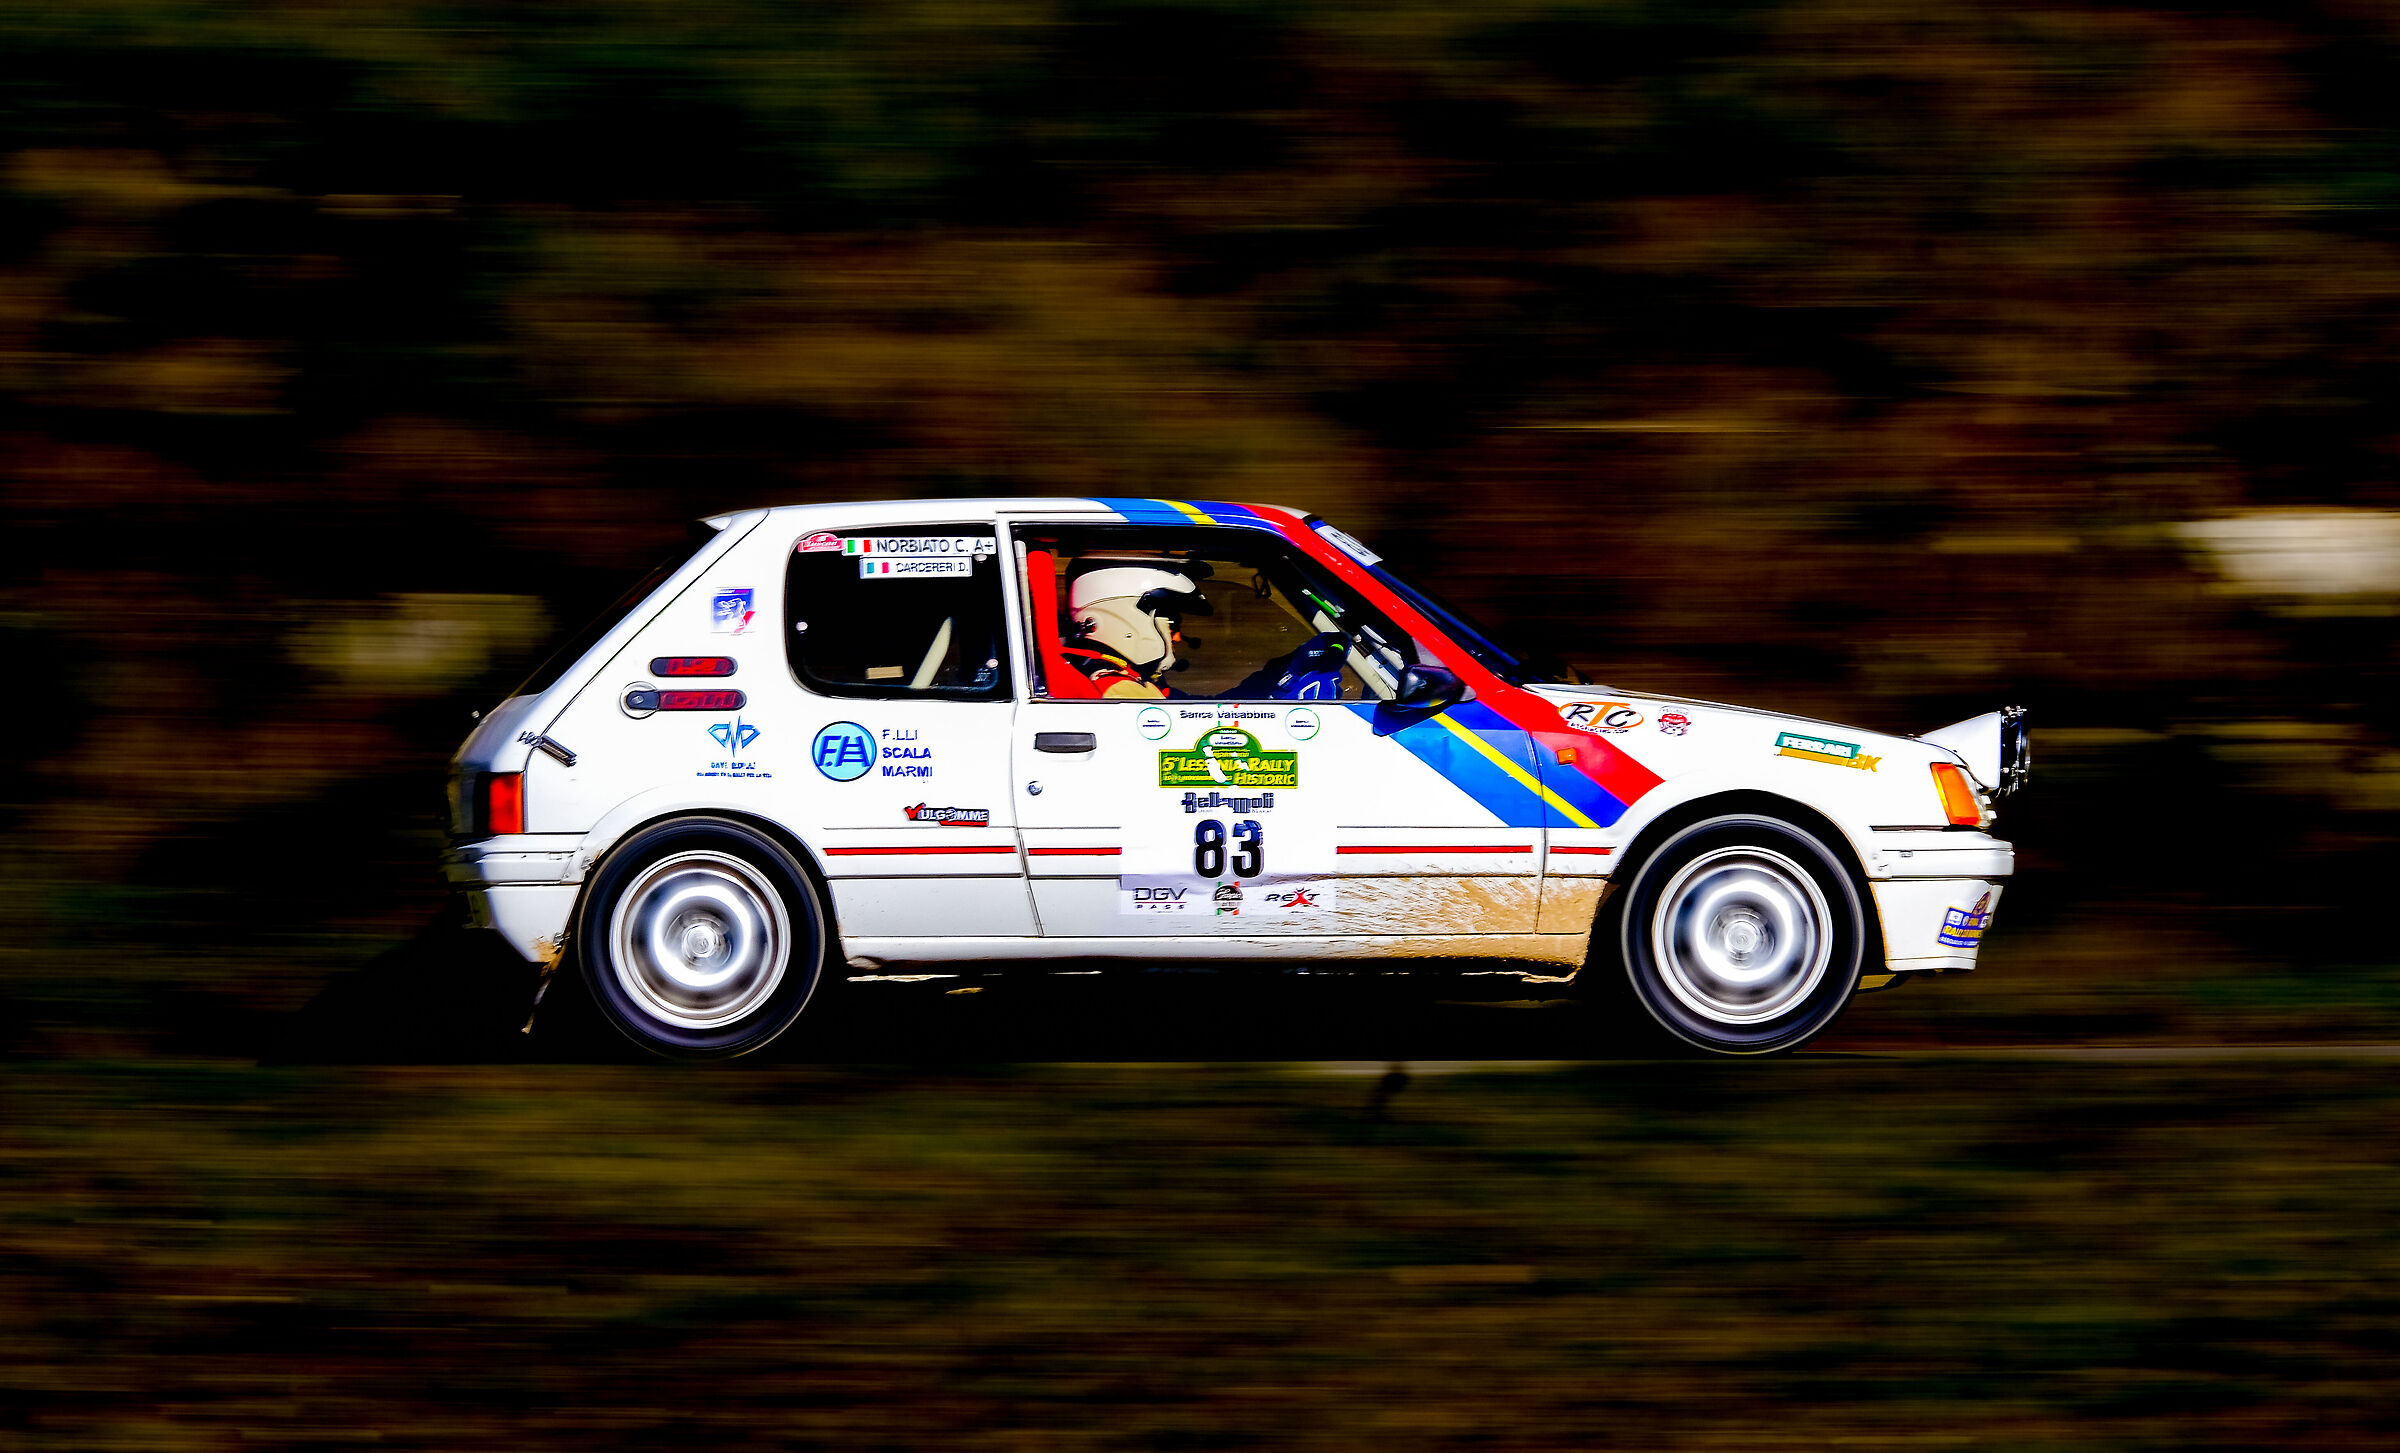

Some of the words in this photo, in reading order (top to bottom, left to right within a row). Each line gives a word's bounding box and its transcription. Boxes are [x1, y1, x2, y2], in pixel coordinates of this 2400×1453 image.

[876, 539, 949, 553] NORBIATO
[955, 539, 969, 553] C.
[896, 562, 956, 573] CARCERERI
[958, 562, 969, 573] D.
[1566, 702, 1636, 728] RTC
[882, 729, 918, 740] F.LLI
[882, 747, 931, 759] SCALA
[1783, 737, 1853, 758] FERRARI
[1178, 757, 1244, 771] LESSNIA
[1248, 757, 1294, 771] RALLY
[882, 765, 933, 777] MARMI
[1234, 773, 1295, 786] HISTORIC
[1195, 819, 1264, 878] 83
[1133, 887, 1187, 900] DGV
